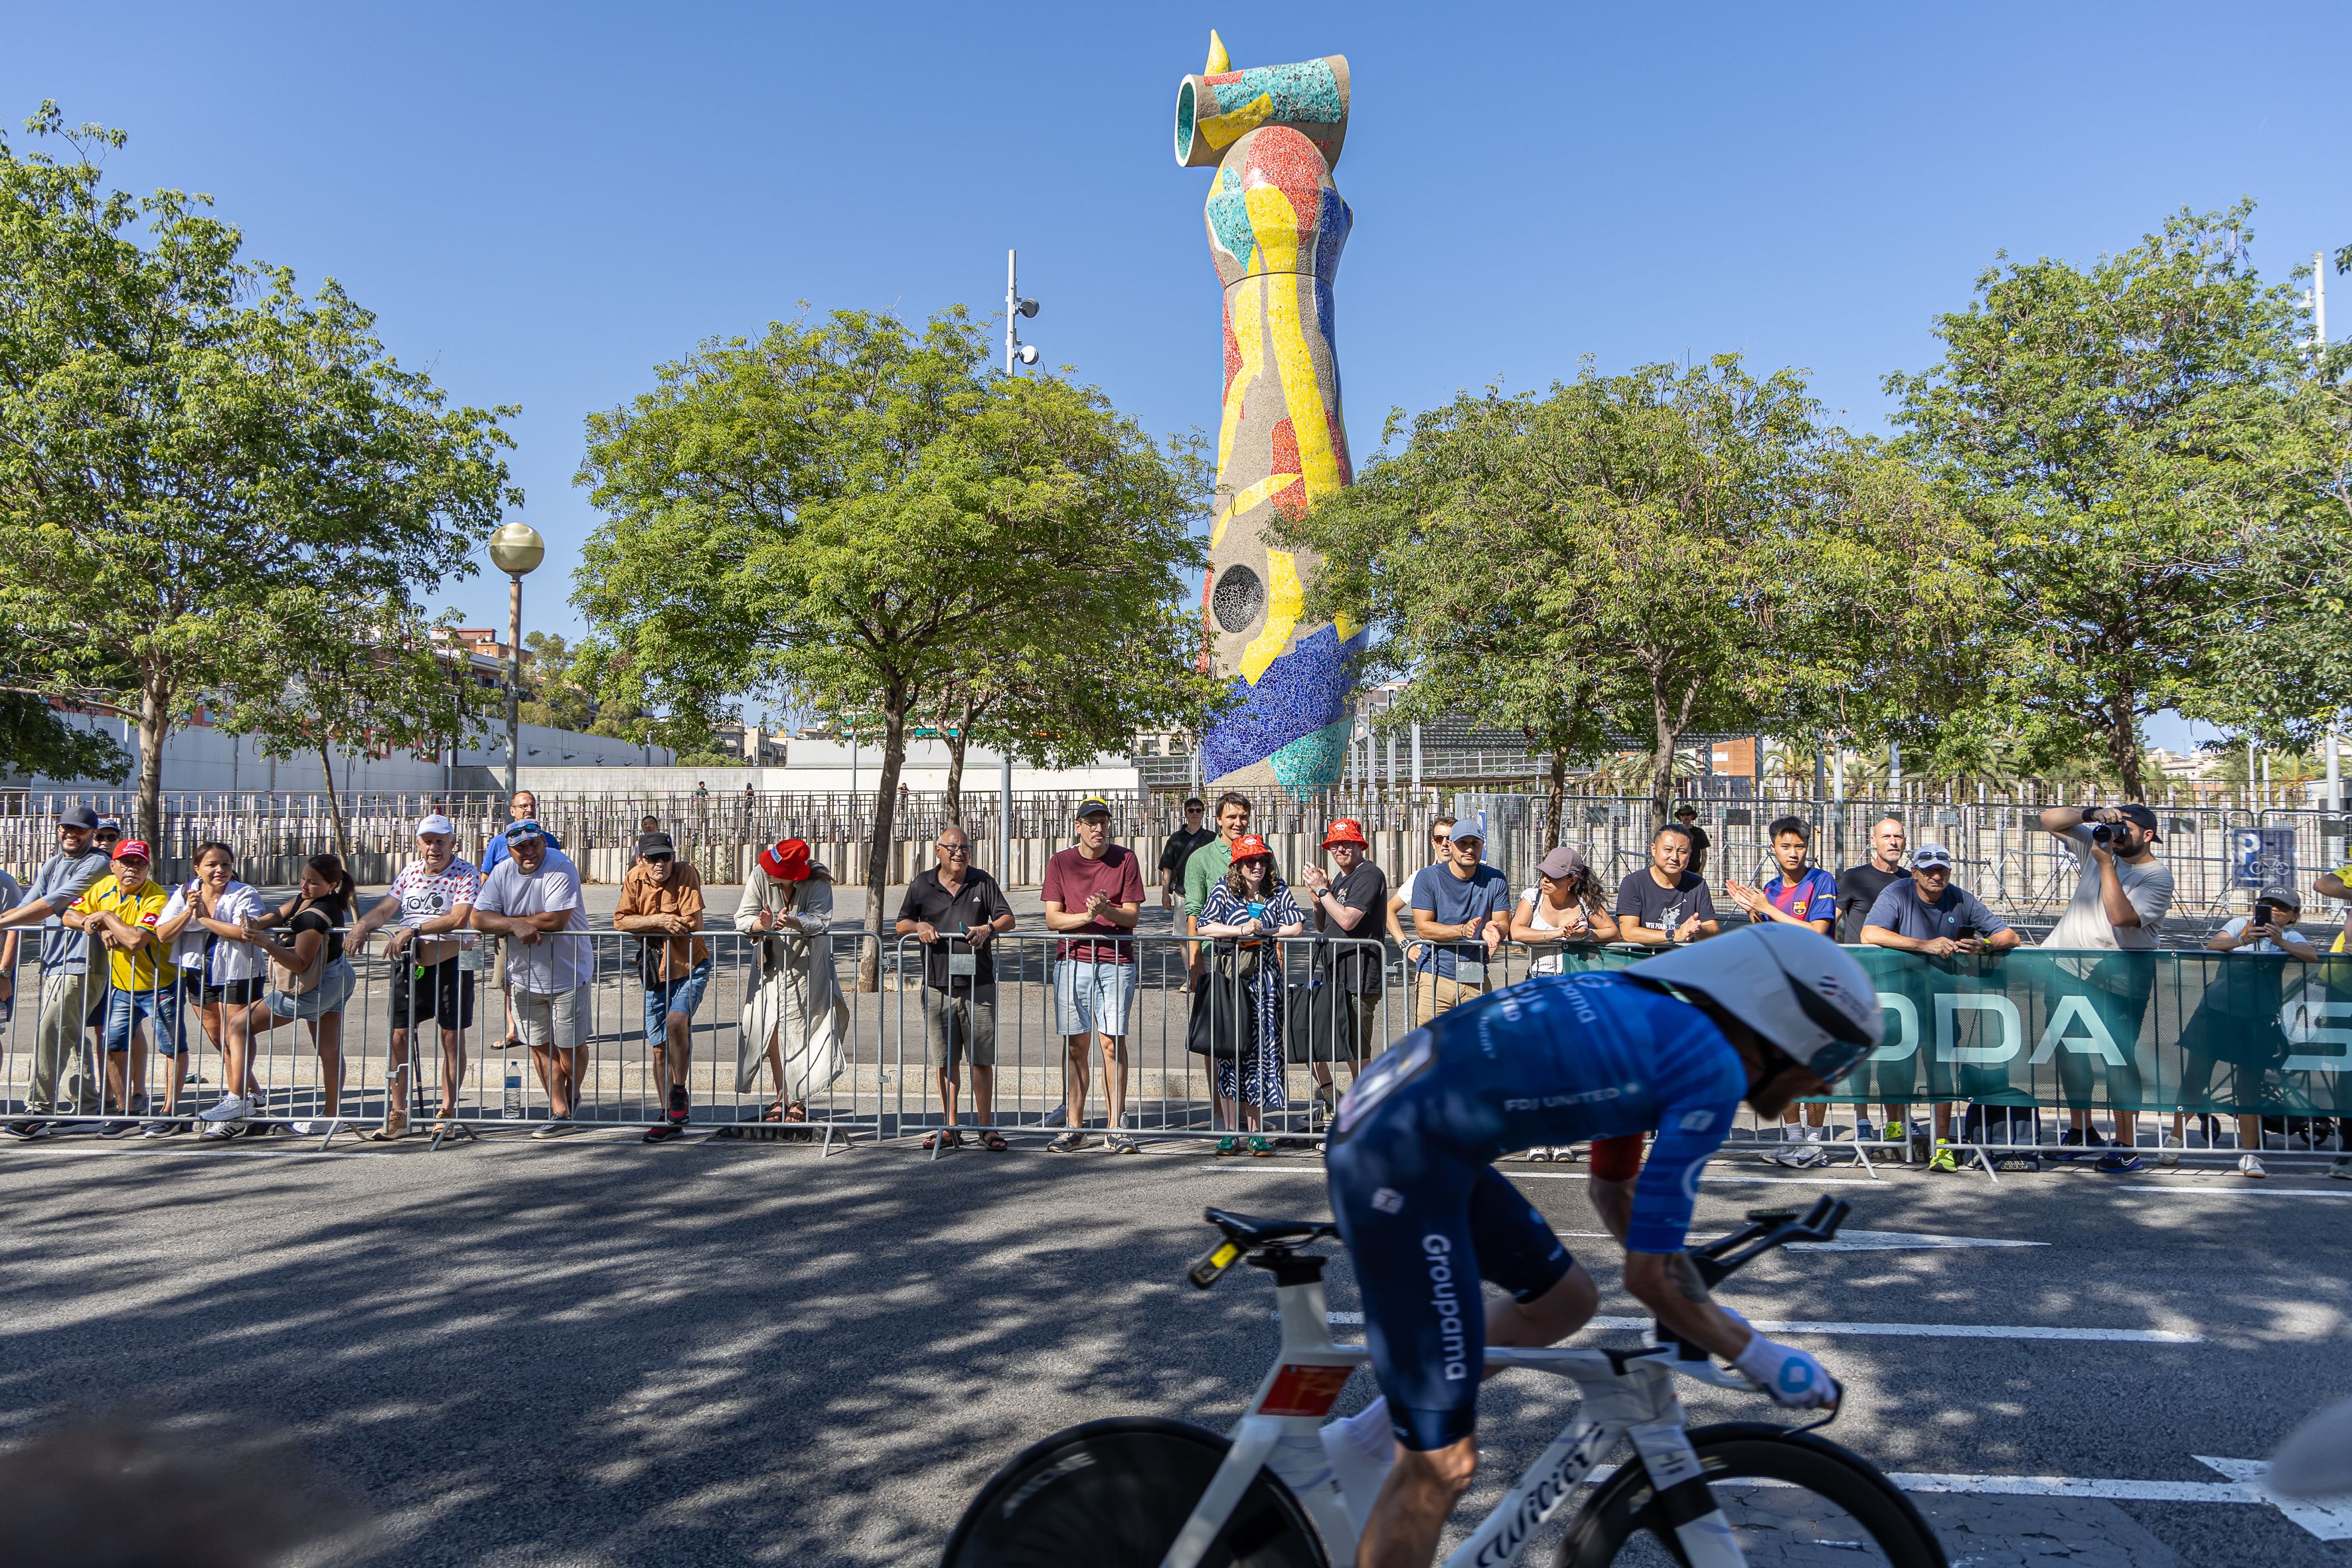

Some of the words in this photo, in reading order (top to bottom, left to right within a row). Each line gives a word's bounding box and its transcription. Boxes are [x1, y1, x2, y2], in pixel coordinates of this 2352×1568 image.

[2238, 833, 2260, 865] P
[1866, 992, 2128, 1066] ODA
[2281, 1001, 2352, 1071] S
[1504, 1098, 1539, 1112] FDJ
[1542, 1087, 1620, 1108] UNITED
[1421, 1233, 1467, 1380] Groupama
